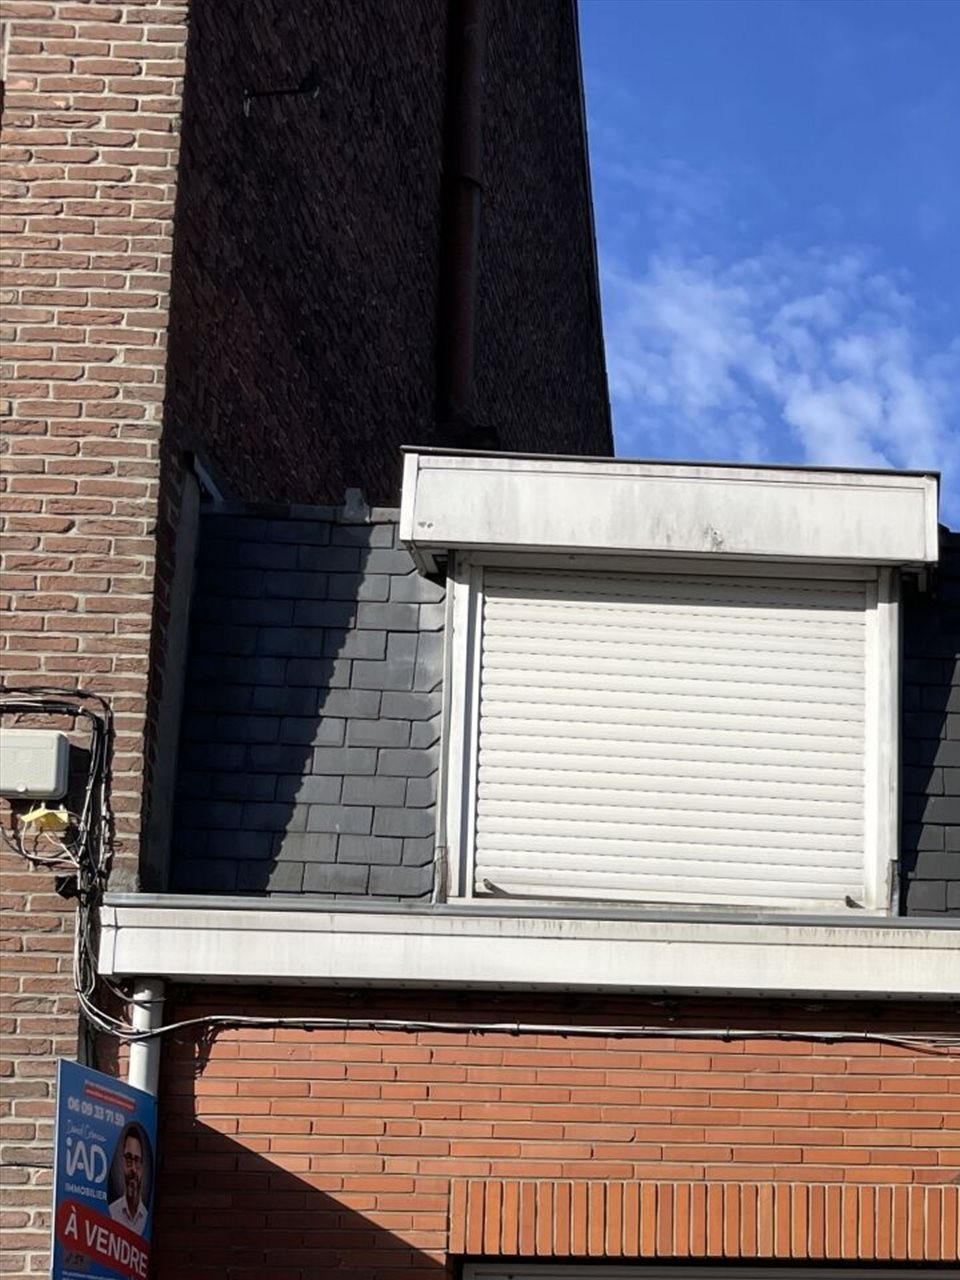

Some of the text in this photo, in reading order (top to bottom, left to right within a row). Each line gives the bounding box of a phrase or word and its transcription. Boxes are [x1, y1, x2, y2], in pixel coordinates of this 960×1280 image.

[64, 1182, 107, 1201] IMMOBILIER
[64, 1204, 149, 1279] À VENDRE
